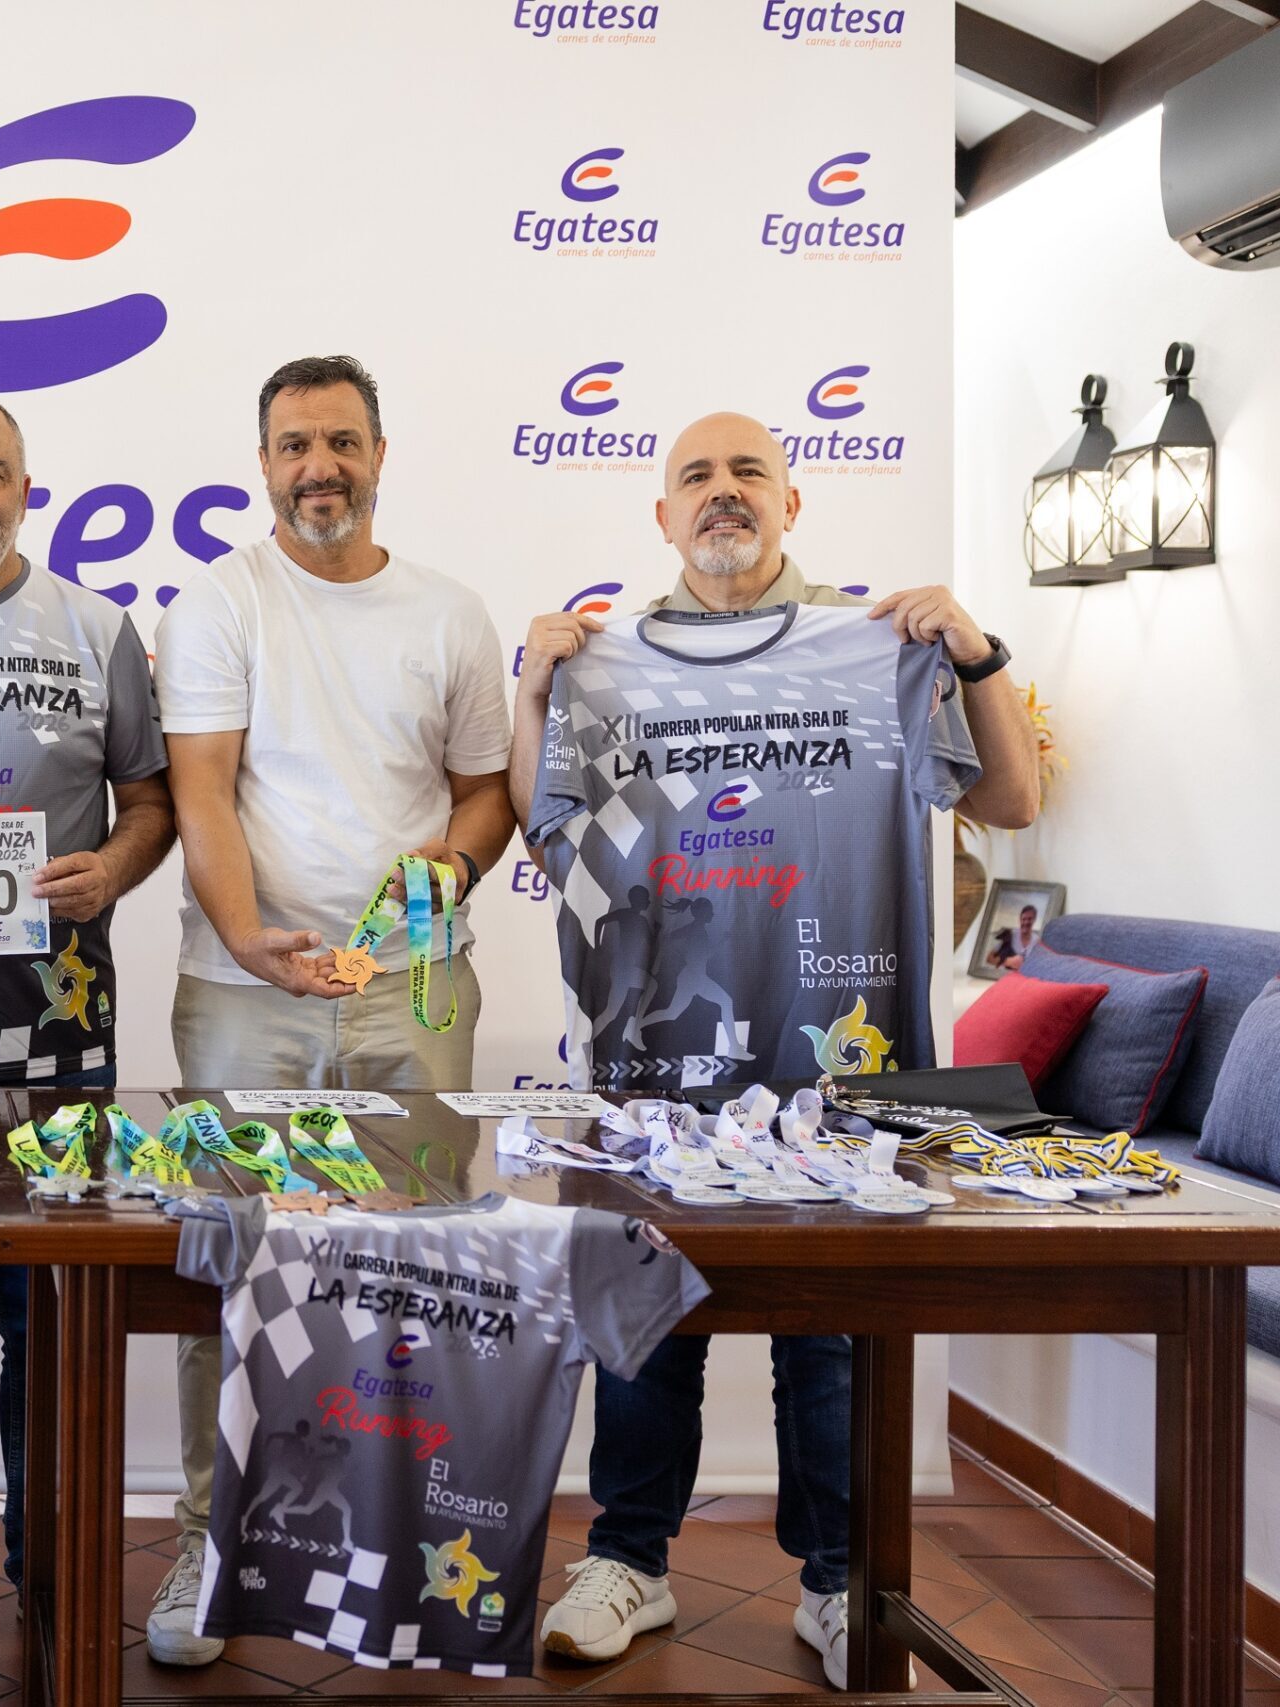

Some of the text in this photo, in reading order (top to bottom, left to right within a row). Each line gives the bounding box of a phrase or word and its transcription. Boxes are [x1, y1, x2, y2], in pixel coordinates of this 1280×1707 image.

[513, 0, 659, 37] Egatesa
[762, 0, 905, 40] Egatesa
[592, 33, 604, 44] de
[840, 37, 851, 48] de
[513, 210, 659, 251] Egatesa
[761, 213, 905, 255] Egatesa
[592, 247, 604, 258] de
[838, 250, 850, 262] de
[513, 424, 657, 465] Egatesa
[768, 428, 905, 468] gatesa
[591, 461, 603, 472] de
[837, 464, 849, 475] de
[7, 656, 39, 674] NTRA
[41, 658, 64, 676] SRA
[67, 661, 81, 678] DE
[16, 711, 70, 733] 2026
[601, 709, 849, 745] XII CARRERA POPULAR NTRA SRA DE
[546, 744, 576, 760] CHIP
[614, 738, 854, 780] LA ESPERANZA
[545, 760, 570, 771] ARIAS
[776, 769, 836, 793] 2026
[1, 820, 14, 829] SRA
[15, 820, 24, 829] DE
[679, 827, 775, 857] Egatesa
[648, 853, 806, 909] Running
[796, 918, 821, 944] El
[798, 947, 897, 975] Rosario
[799, 975, 897, 989] TU AYUNTAMIENTO
[264, 1101, 368, 1109] 399
[482, 1104, 590, 1112] 398
[304, 1235, 520, 1302] XII CARRERA POPULAR NTRA SRA DE
[307, 1277, 519, 1345] LA ESPERANZA
[352, 1368, 434, 1400] Egatesa
[317, 1386, 454, 1461] Running
[429, 1457, 449, 1482] El
[426, 1482, 509, 1519] Rosario
[424, 1505, 507, 1530] TU AYUNTAMIENTO
